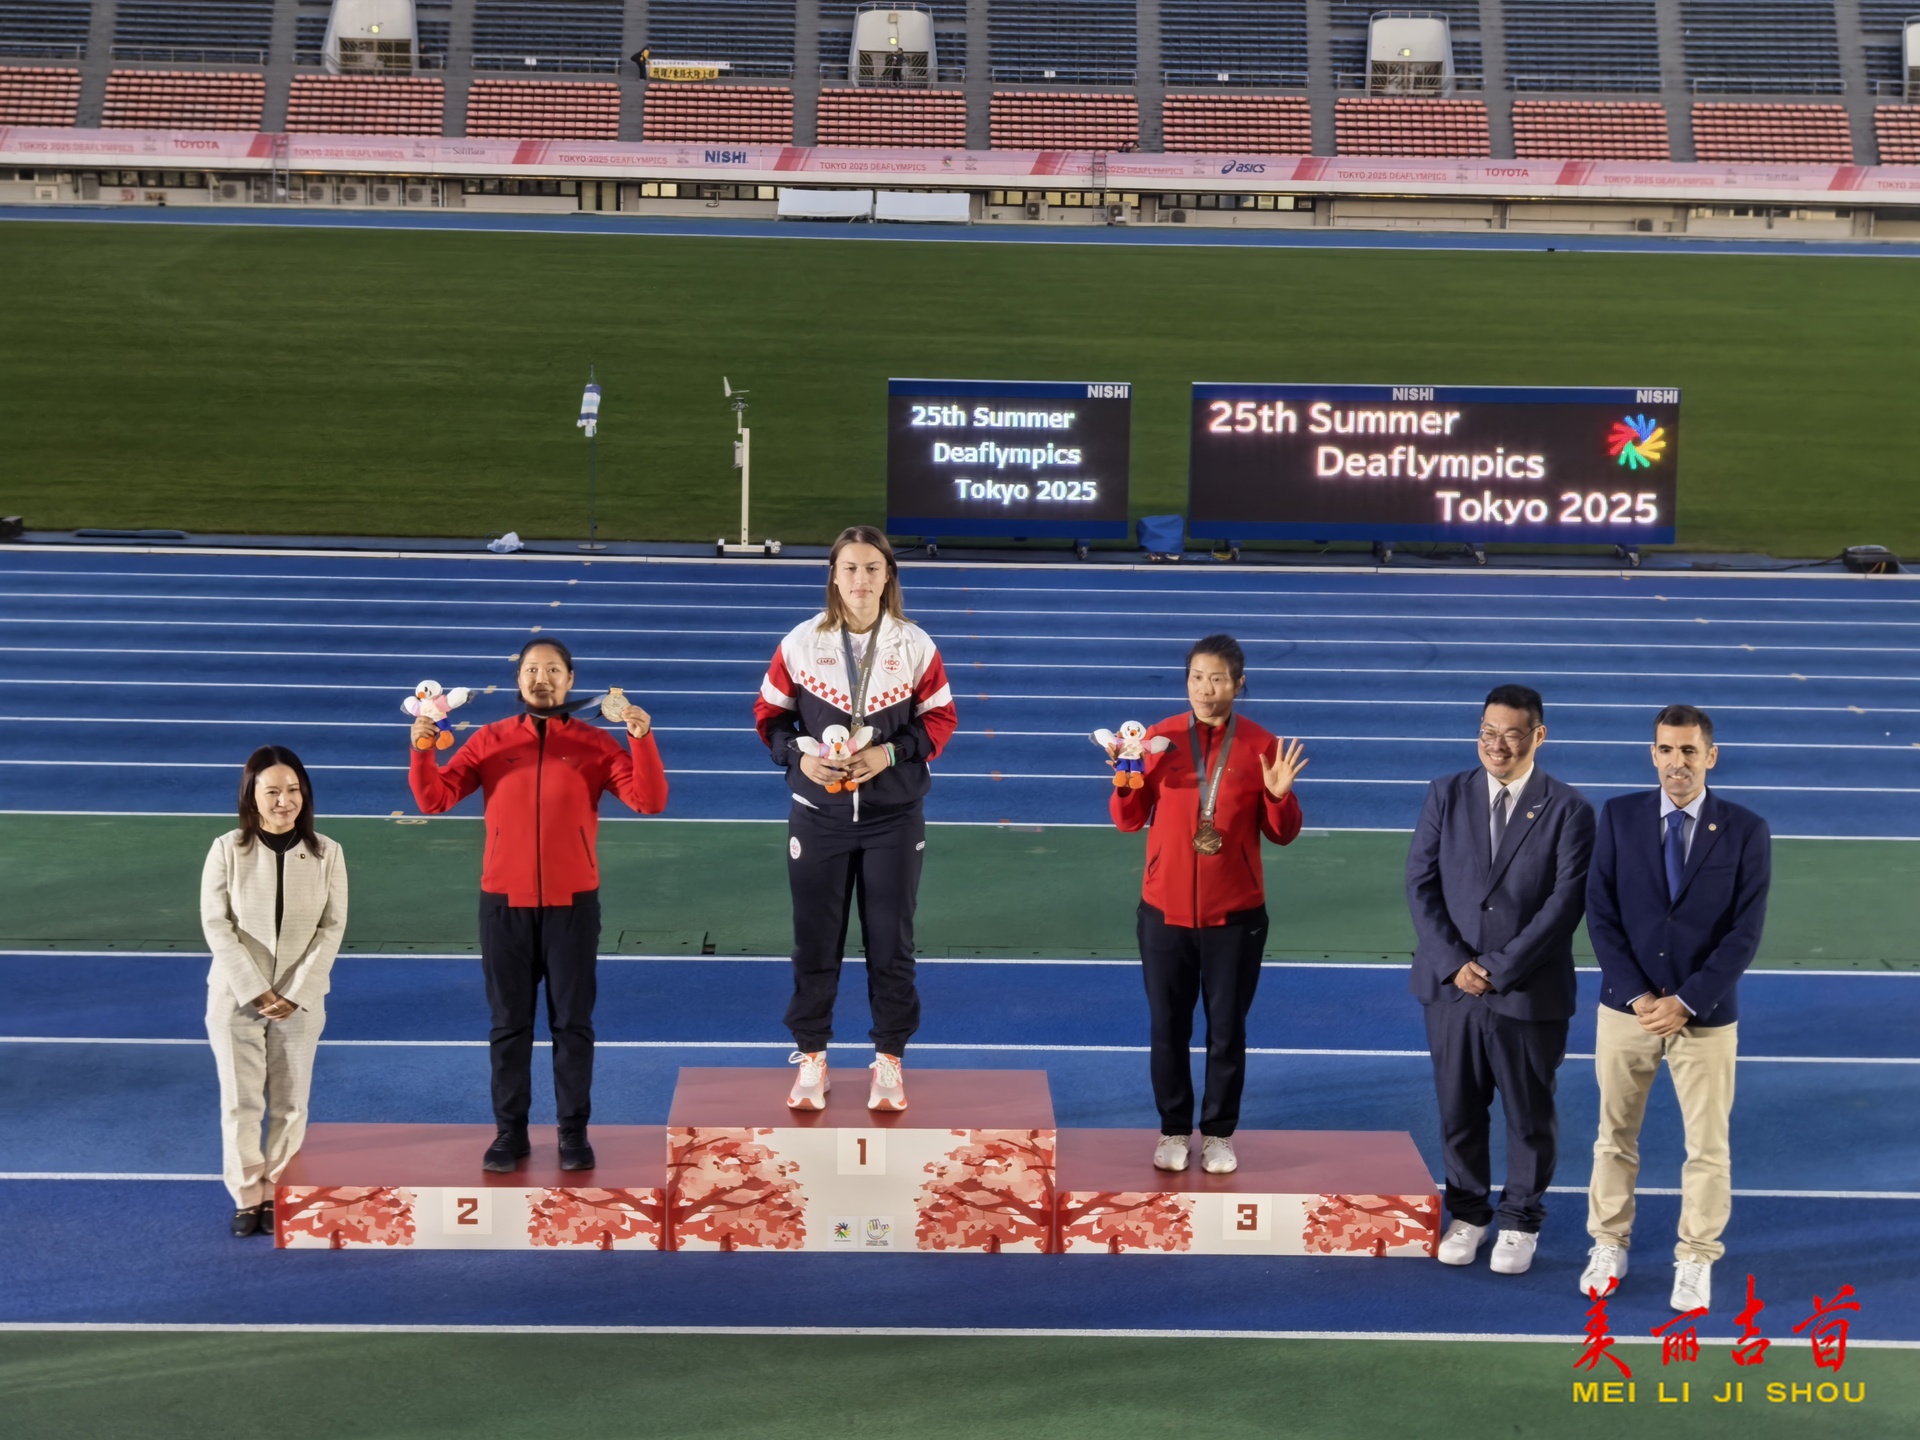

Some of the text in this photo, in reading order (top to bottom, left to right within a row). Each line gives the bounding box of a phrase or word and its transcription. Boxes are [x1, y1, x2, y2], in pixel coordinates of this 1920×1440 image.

[173, 139, 220, 150] TOYOTA
[558, 154, 586, 163] TOKYO
[610, 156, 668, 165] DEAFLYMPICS
[704, 150, 747, 164] NISHI
[819, 161, 926, 172] TOKYO 2025 DEAFLYMPICS
[1485, 168, 1529, 178] TOYOTA
[1337, 171, 1365, 180] TOKYO
[1367, 171, 1387, 180] 2025
[1389, 172, 1447, 181] DEAFLYMPICS
[1603, 175, 1631, 184] TOKYO
[1087, 385, 1129, 398] NISHI
[1393, 388, 1434, 401] NISHI
[1636, 390, 1678, 403] NISHI
[911, 404, 1075, 428] 25th Summer
[1209, 401, 1460, 435] 25th Summer
[933, 441, 1082, 470] Deaflympics
[1316, 445, 1545, 480] Deaflympics
[955, 479, 1098, 505] Tokyo 2025
[1435, 490, 1658, 524] Tokyo 2025
[857, 1138, 866, 1165] 1
[457, 1197, 478, 1224] 2
[1237, 1204, 1257, 1230] 3
